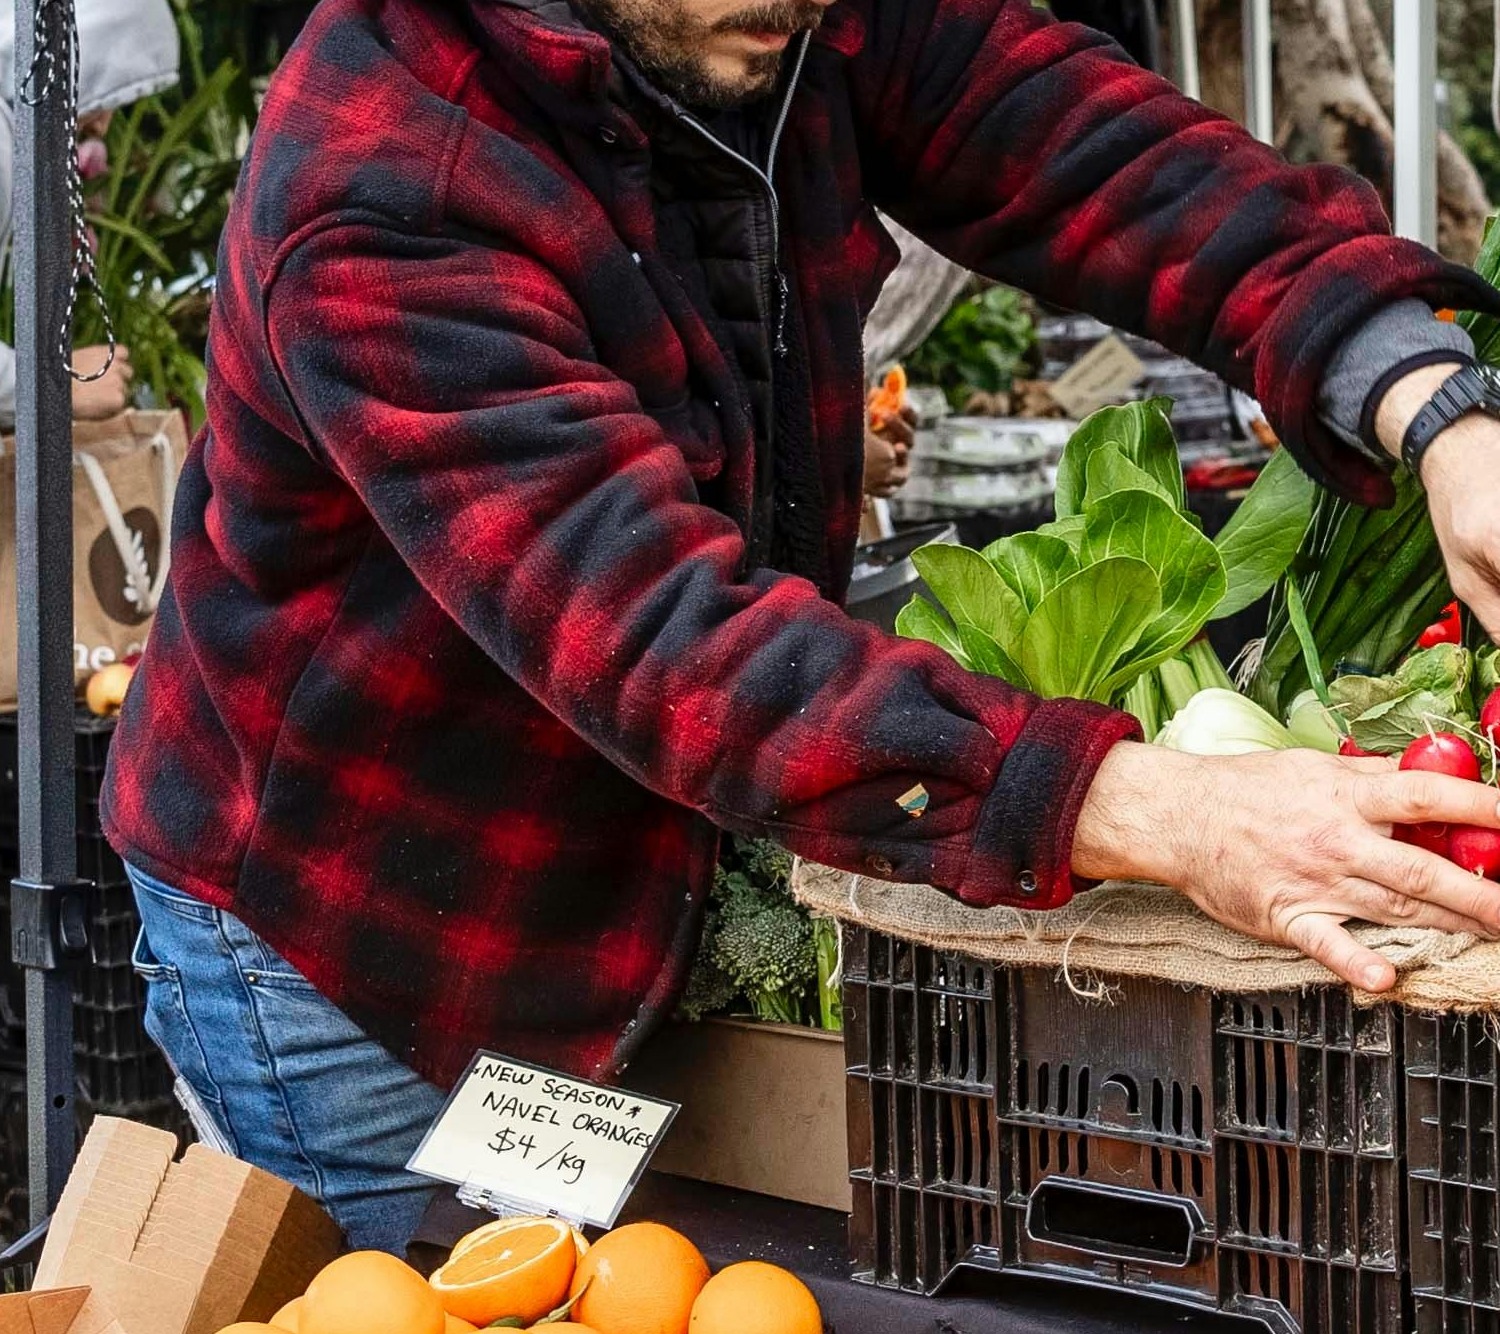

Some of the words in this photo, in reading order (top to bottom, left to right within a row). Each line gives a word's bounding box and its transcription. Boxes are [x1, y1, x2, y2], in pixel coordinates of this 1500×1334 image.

[481, 1063, 534, 1086] NEW
[541, 1078, 626, 1112] SEASON
[482, 1091, 561, 1127] NAVEL
[572, 1113, 655, 1150] ORANGES
